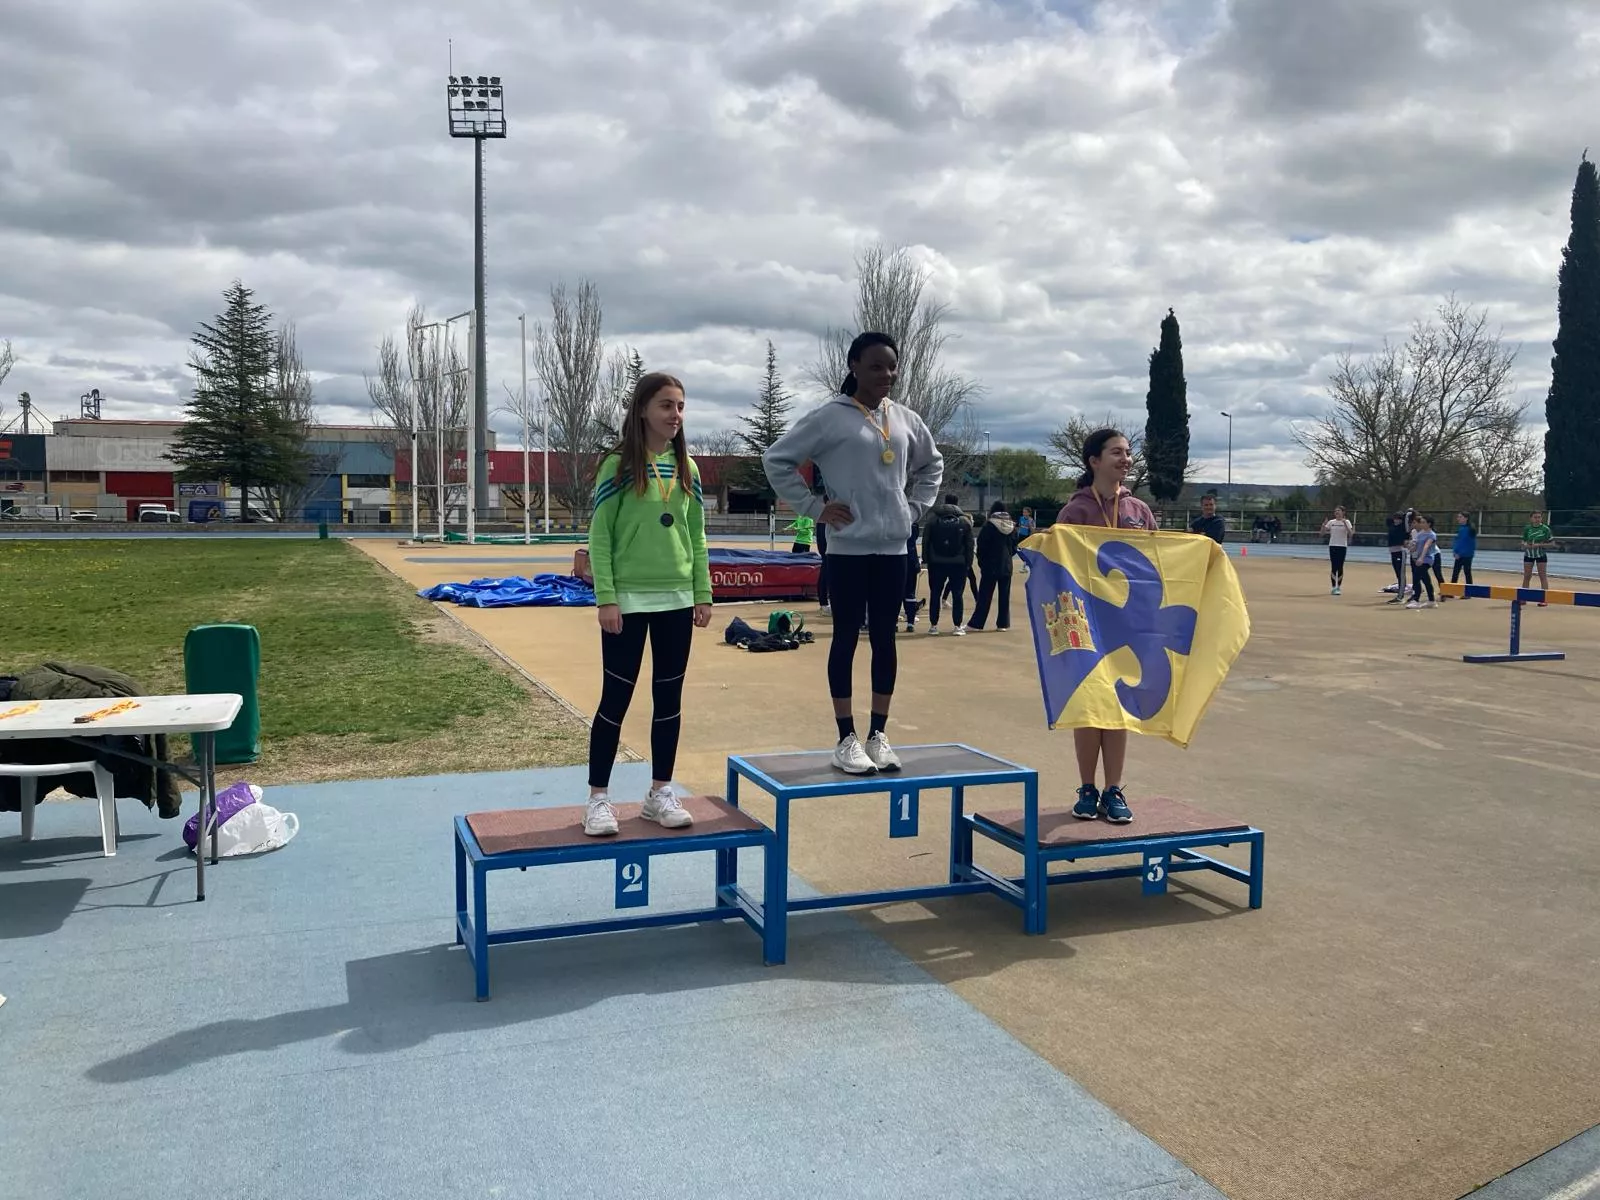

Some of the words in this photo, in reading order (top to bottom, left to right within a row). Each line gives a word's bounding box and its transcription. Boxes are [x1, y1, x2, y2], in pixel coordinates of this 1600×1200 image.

[710, 571, 764, 586] ONDO
[898, 793, 911, 821] 1
[621, 863, 643, 893] 2
[1147, 857, 1164, 882] 3
